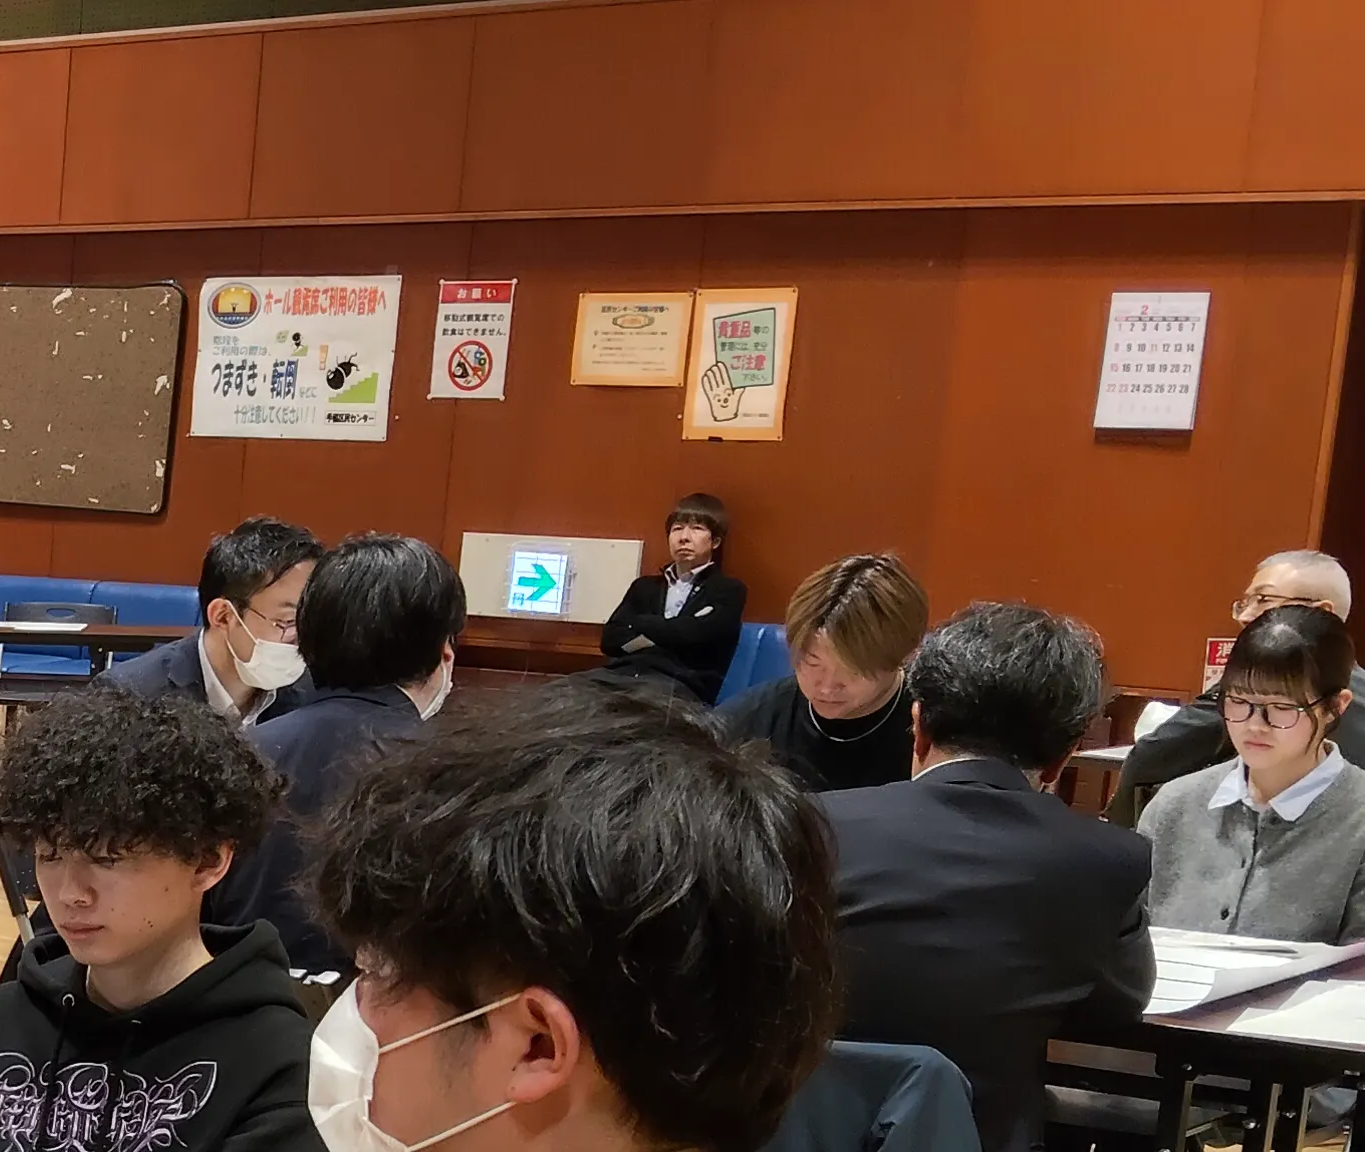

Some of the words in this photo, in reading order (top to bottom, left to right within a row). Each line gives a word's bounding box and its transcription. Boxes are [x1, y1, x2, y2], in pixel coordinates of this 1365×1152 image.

[456, 287, 497, 300] お願い
[1140, 304, 1149, 316] 2
[1137, 343, 1146, 353] 10
[1162, 343, 1170, 353] 12
[1173, 343, 1182, 353] 13
[1186, 343, 1195, 353] 14
[1110, 363, 1118, 373] 15
[1122, 363, 1131, 373] 16
[1135, 363, 1143, 373] 17
[1146, 363, 1155, 373] 18
[1158, 363, 1167, 373] 19
[1170, 363, 1180, 373] 20
[1182, 363, 1191, 373] 21
[1106, 383, 1116, 394] 22
[1118, 383, 1128, 394] 23
[1130, 383, 1140, 394] 24
[1142, 383, 1153, 394] 25
[1154, 383, 1165, 394] 26
[1167, 383, 1177, 394] 27
[1178, 383, 1189, 394] 28
